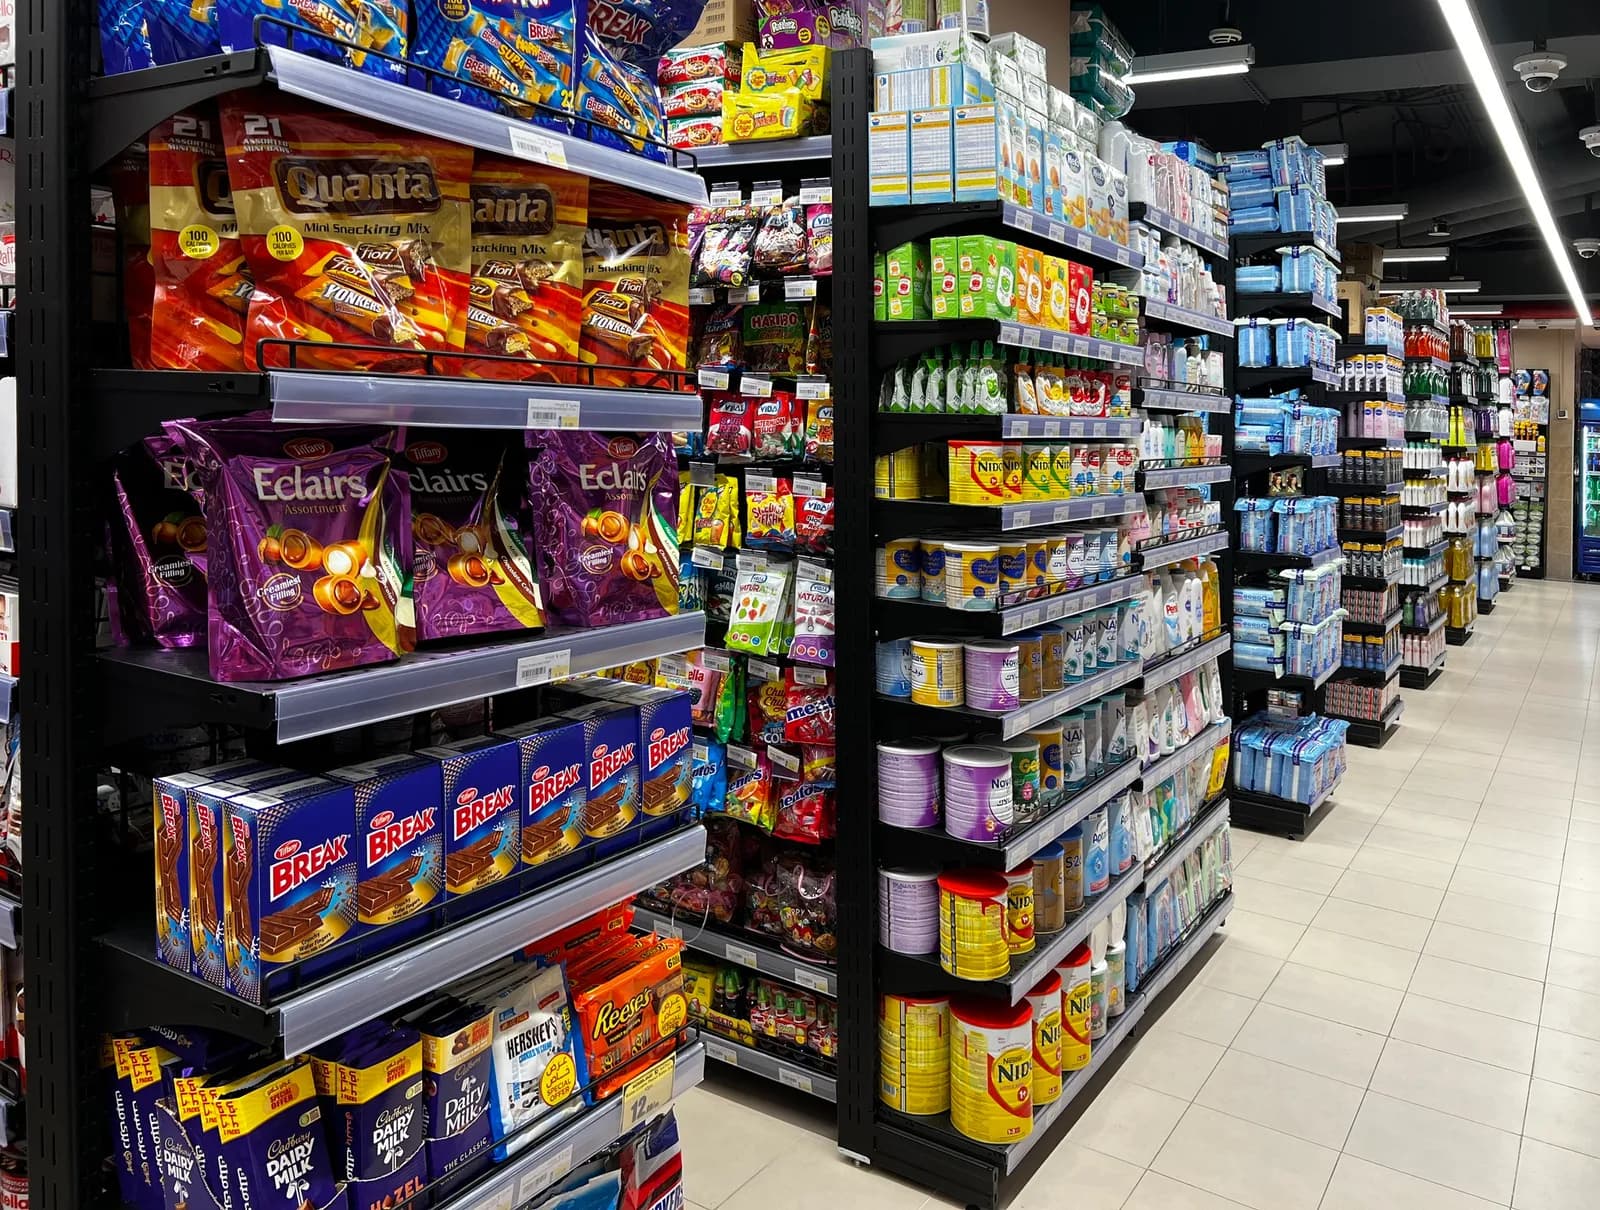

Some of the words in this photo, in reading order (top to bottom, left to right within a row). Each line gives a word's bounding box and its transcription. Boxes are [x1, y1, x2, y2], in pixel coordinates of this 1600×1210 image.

[498, 44, 526, 69] SUPA
[614, 85, 635, 108] SUPA
[173, 115, 210, 139] 21
[244, 114, 282, 138] 21
[287, 166, 432, 208] Quanta
[189, 230, 208, 242] 100
[273, 231, 292, 243] 100
[304, 223, 330, 233] Mini
[333, 224, 401, 237] Snacking
[407, 223, 431, 234] Mix
[360, 247, 394, 261] Fiori
[521, 243, 546, 255] Mix
[486, 262, 513, 276] Fiori
[598, 263, 646, 275] Snacking
[621, 278, 642, 292] Fiori
[323, 283, 383, 313] YONKERS
[596, 292, 627, 309] Fiori
[589, 314, 634, 336] YONKER
[751, 312, 798, 329] HARIBO
[289, 441, 326, 456] Tiffany
[413, 446, 442, 460] Tiffany
[253, 465, 369, 501] Eclairs
[579, 463, 648, 492] Eclairs
[285, 503, 348, 515] Assortment
[758, 513, 780, 527] FISH
[147, 558, 193, 574] Creamiest
[159, 567, 186, 579] Filling
[256, 574, 302, 598] Creamiest
[270, 588, 297, 602] Filling
[999, 696, 1005, 704] 2
[648, 728, 690, 772] BREAK
[590, 744, 634, 791] BREAK
[529, 764, 581, 816] BREAK
[161, 793, 177, 841] BREAK
[454, 785, 514, 841] BREAK
[986, 818, 996, 832] 3
[197, 803, 212, 849] BREAK
[231, 814, 247, 864] BREAK
[367, 808, 435, 869] BREAK
[270, 835, 348, 902] BREAK
[593, 987, 652, 1040] Reese's
[507, 1017, 558, 1060] HERSHEY'S
[546, 1078, 572, 1096] SPECIAL
[549, 1086, 571, 1102] OFFER
[445, 1082, 486, 1119] Dairy
[631, 1095, 648, 1124] 12
[373, 1109, 416, 1145] DAIRY
[376, 1102, 413, 1129] Cadbury
[446, 1104, 480, 1137] Milk
[164, 1138, 193, 1159] Cadbury
[267, 1131, 311, 1160] Cadbury
[377, 1127, 410, 1156] MILK
[163, 1149, 194, 1171] DAIRY
[266, 1137, 315, 1178] DAIRY
[443, 1157, 459, 1173] THE
[459, 1137, 488, 1162] CLASSIC
[167, 1167, 192, 1185] MILK
[274, 1156, 315, 1190] MILK
